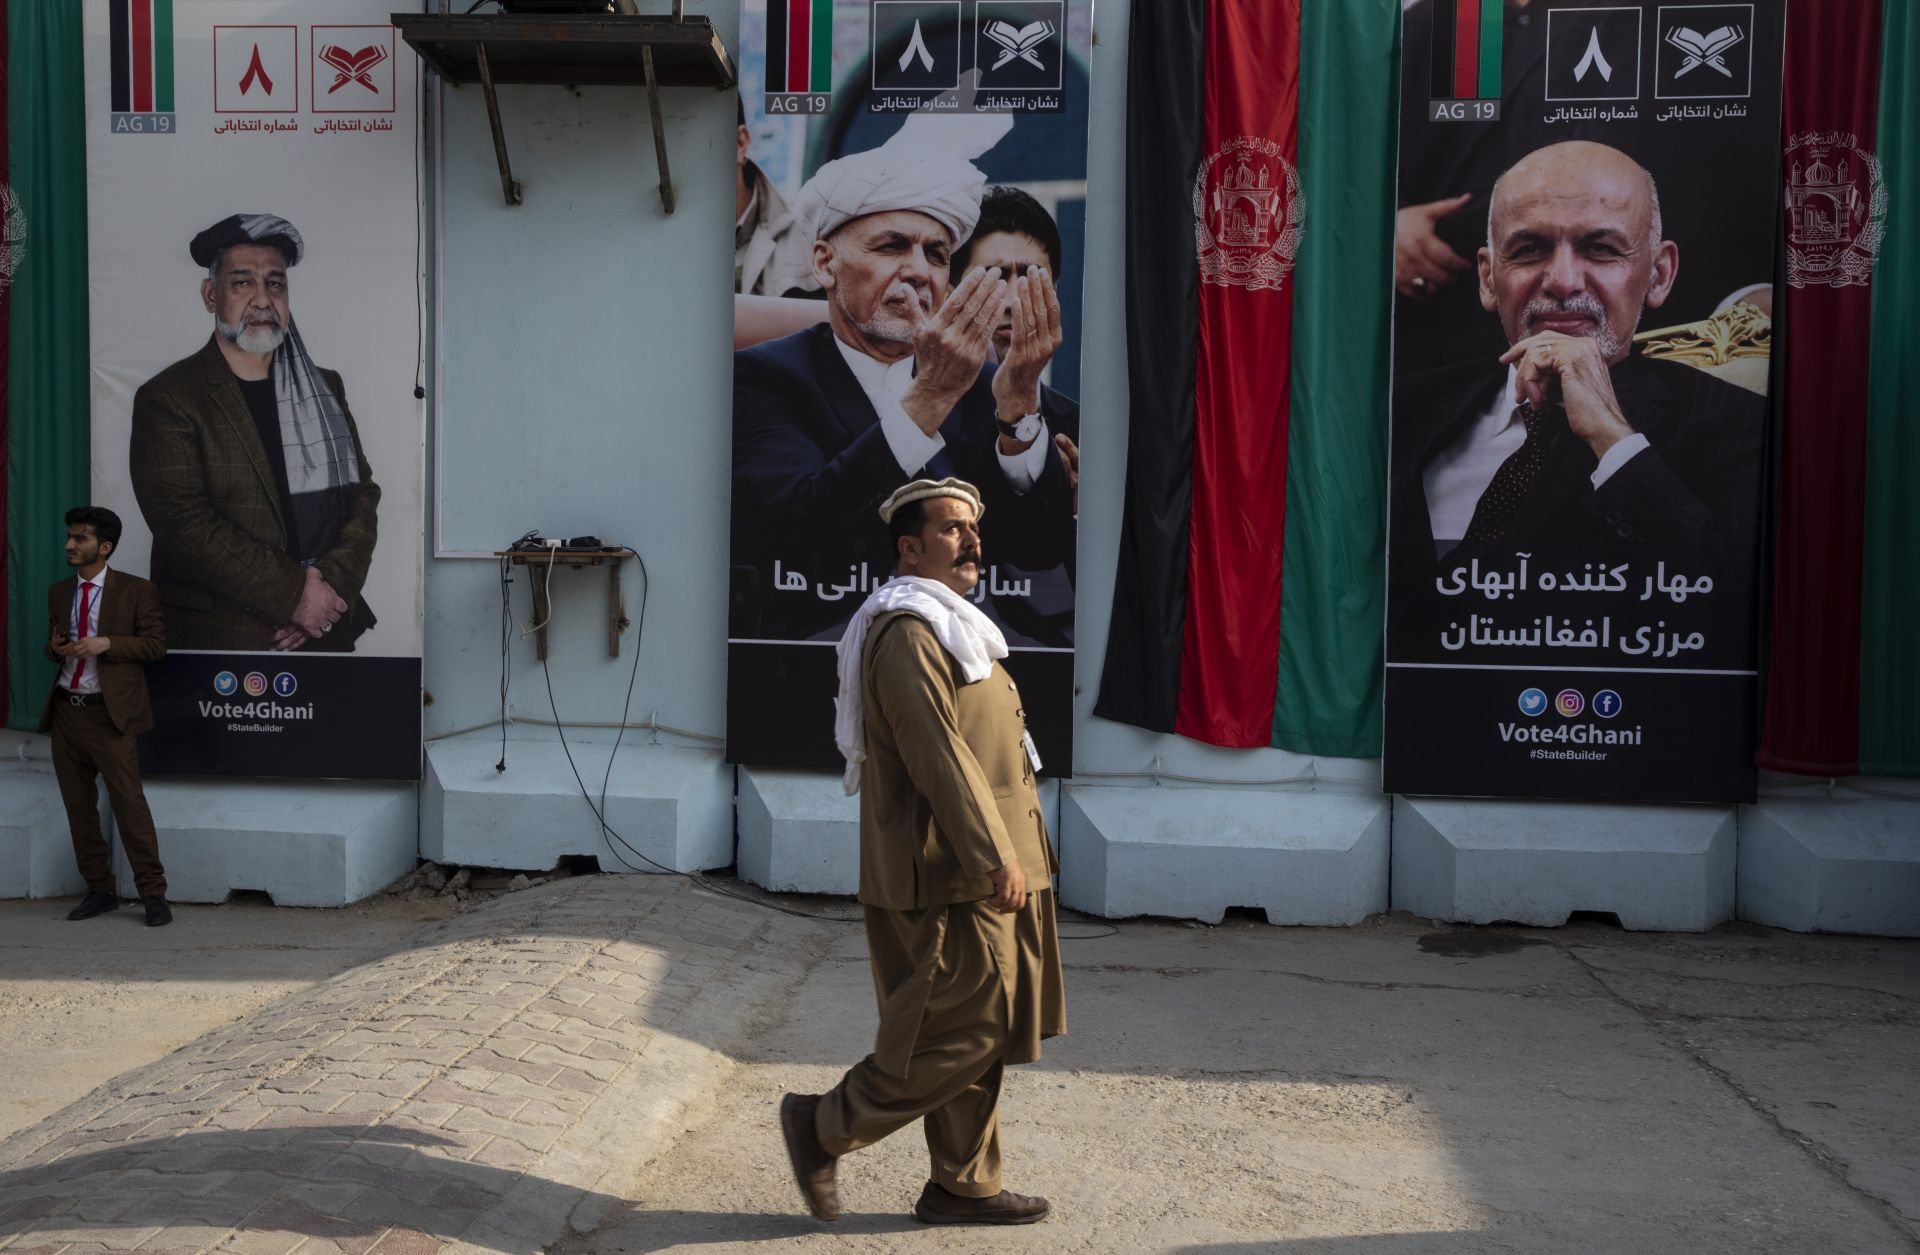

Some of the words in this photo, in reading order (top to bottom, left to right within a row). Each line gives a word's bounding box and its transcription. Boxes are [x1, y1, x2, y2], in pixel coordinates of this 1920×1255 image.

[770, 96, 798, 113] AG
[806, 96, 827, 113] 19
[871, 96, 920, 112] انتخاباتی
[922, 95, 960, 112] شماره
[974, 95, 1025, 112] انتخاباتی
[1027, 95, 1059, 111] نشان
[1435, 102, 1466, 119] AG
[1473, 102, 1495, 119] 19
[1713, 103, 1747, 118] نشان
[1543, 106, 1596, 124] انتخاباتی
[1599, 105, 1638, 122] شماره
[1656, 105, 1711, 122] انتخاباتی
[116, 116, 143, 132] AG
[150, 116, 170, 132] 19
[214, 119, 262, 134] انتخاباتی
[263, 119, 299, 133] شماره
[314, 119, 361, 134] انتخاباتی
[364, 119, 393, 133] نشان
[774, 559, 808, 591] ها
[1435, 551, 1533, 600] آبهای
[1538, 563, 1630, 592] کننده
[1639, 561, 1714, 603] مهار
[1440, 614, 1610, 651] افغانستان
[1619, 620, 1705, 658] مرزی
[198, 700, 314, 720] Vote4Ghani
[227, 723, 284, 733] #StateBuilder
[1498, 722, 1642, 745] Vote4Ghani
[1529, 749, 1608, 761] #StateBuilder
